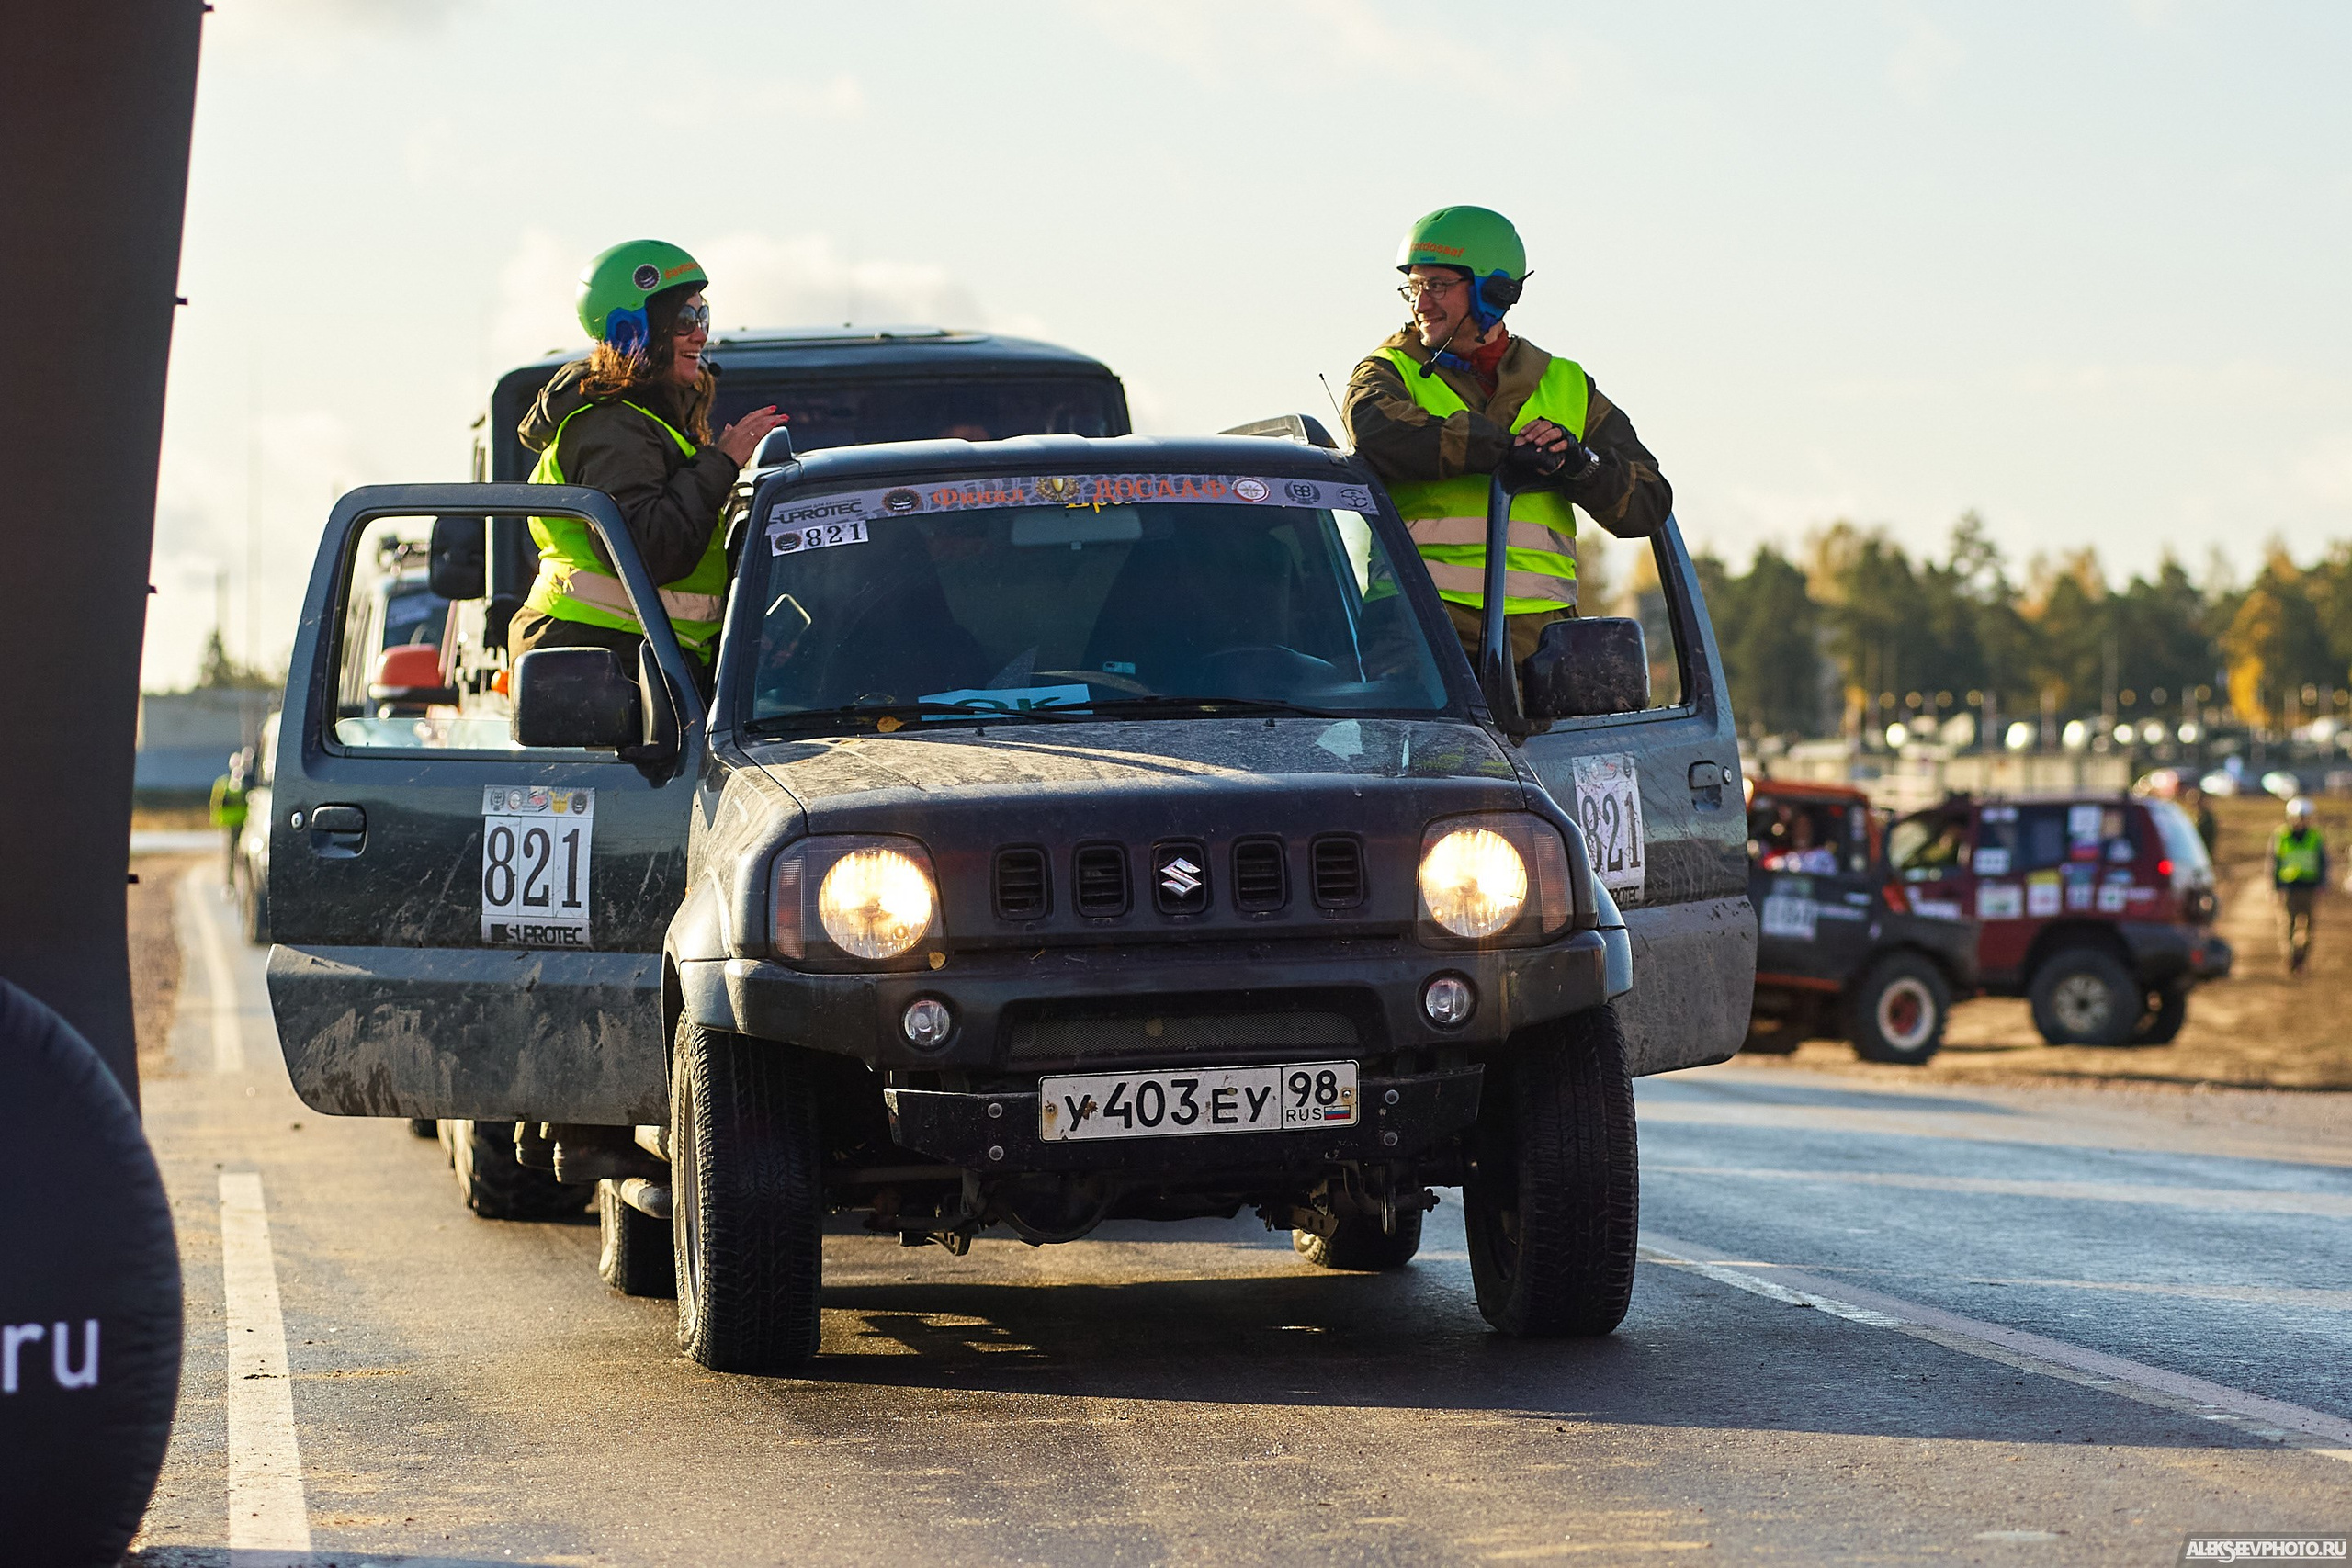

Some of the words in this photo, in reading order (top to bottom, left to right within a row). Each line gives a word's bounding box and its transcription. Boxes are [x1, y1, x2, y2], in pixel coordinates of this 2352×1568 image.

[932, 488, 1025, 507] Финал
[1093, 479, 1227, 502] ДОСААФ
[805, 523, 862, 547] 821
[1581, 791, 1641, 873] 821
[484, 826, 581, 908] 821
[1288, 1070, 1339, 1107] 98
[1285, 1107, 1322, 1122] RUS
[2, 1318, 100, 1394] ru
